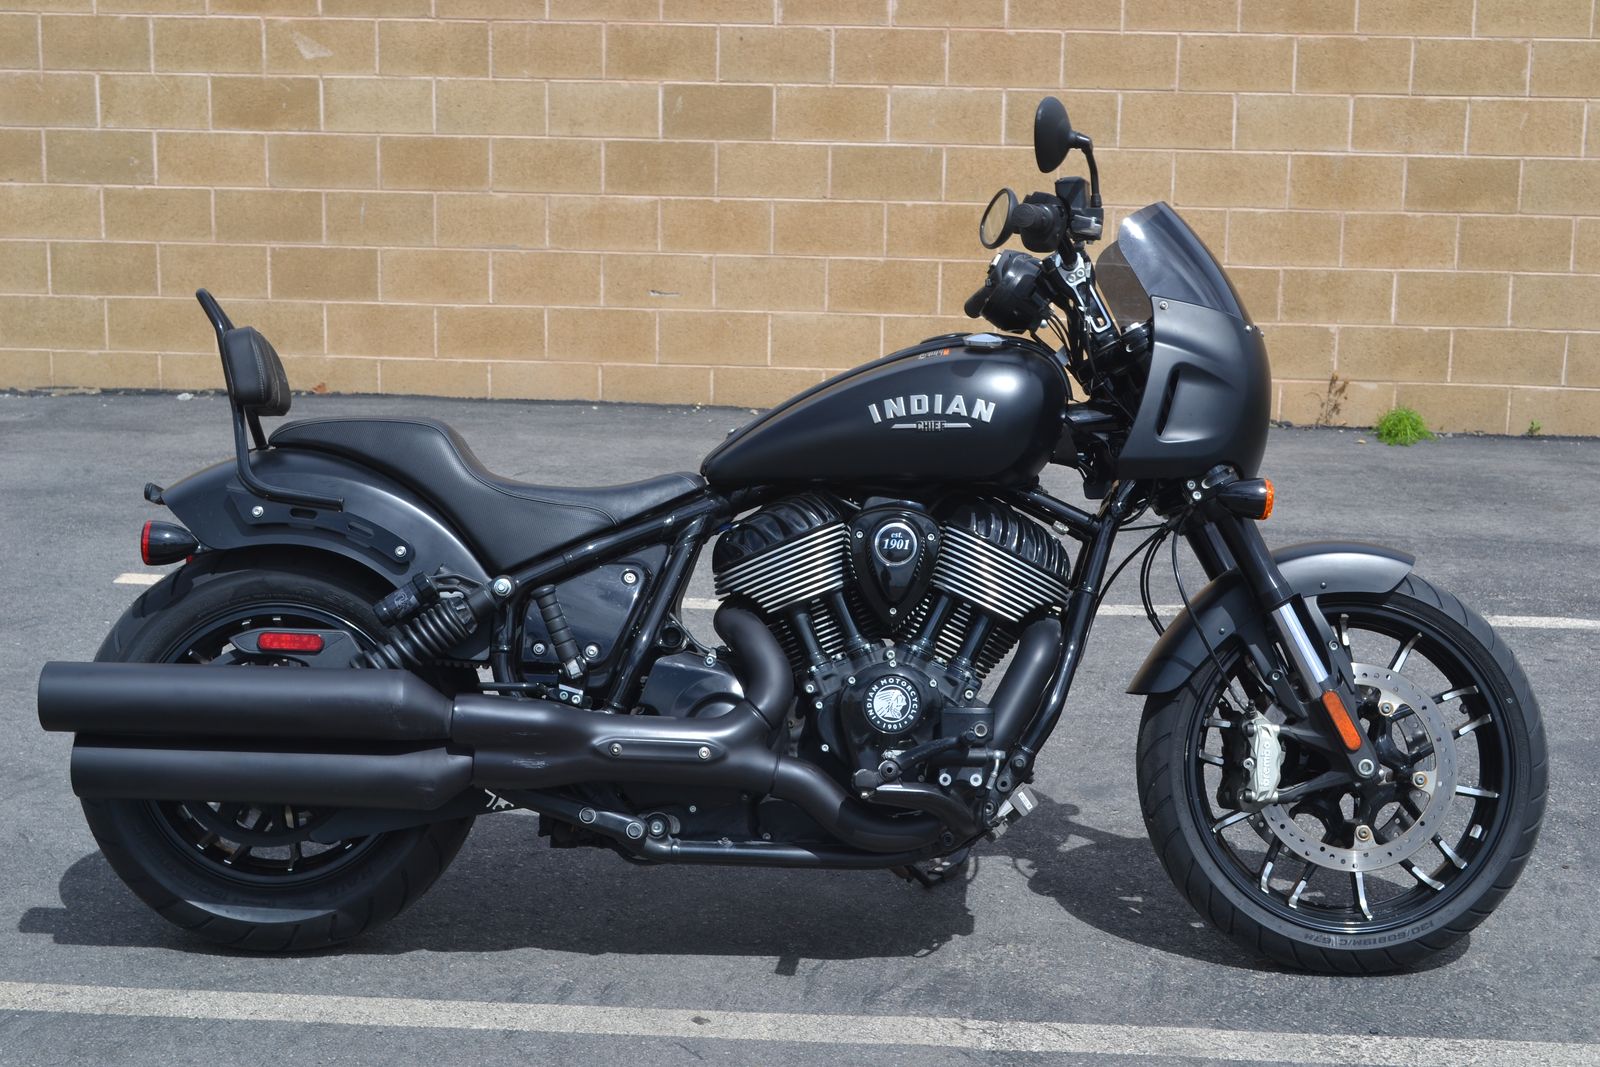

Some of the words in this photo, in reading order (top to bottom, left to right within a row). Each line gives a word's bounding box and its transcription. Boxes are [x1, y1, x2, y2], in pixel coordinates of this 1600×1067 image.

[868, 394, 996, 424] INDIAN
[916, 420, 947, 431] CHIEF
[883, 538, 910, 550] 1901
[867, 685, 879, 720] INDIAN
[880, 678, 918, 720] MOTORCYCLE
[1260, 741, 1271, 788] brembo
